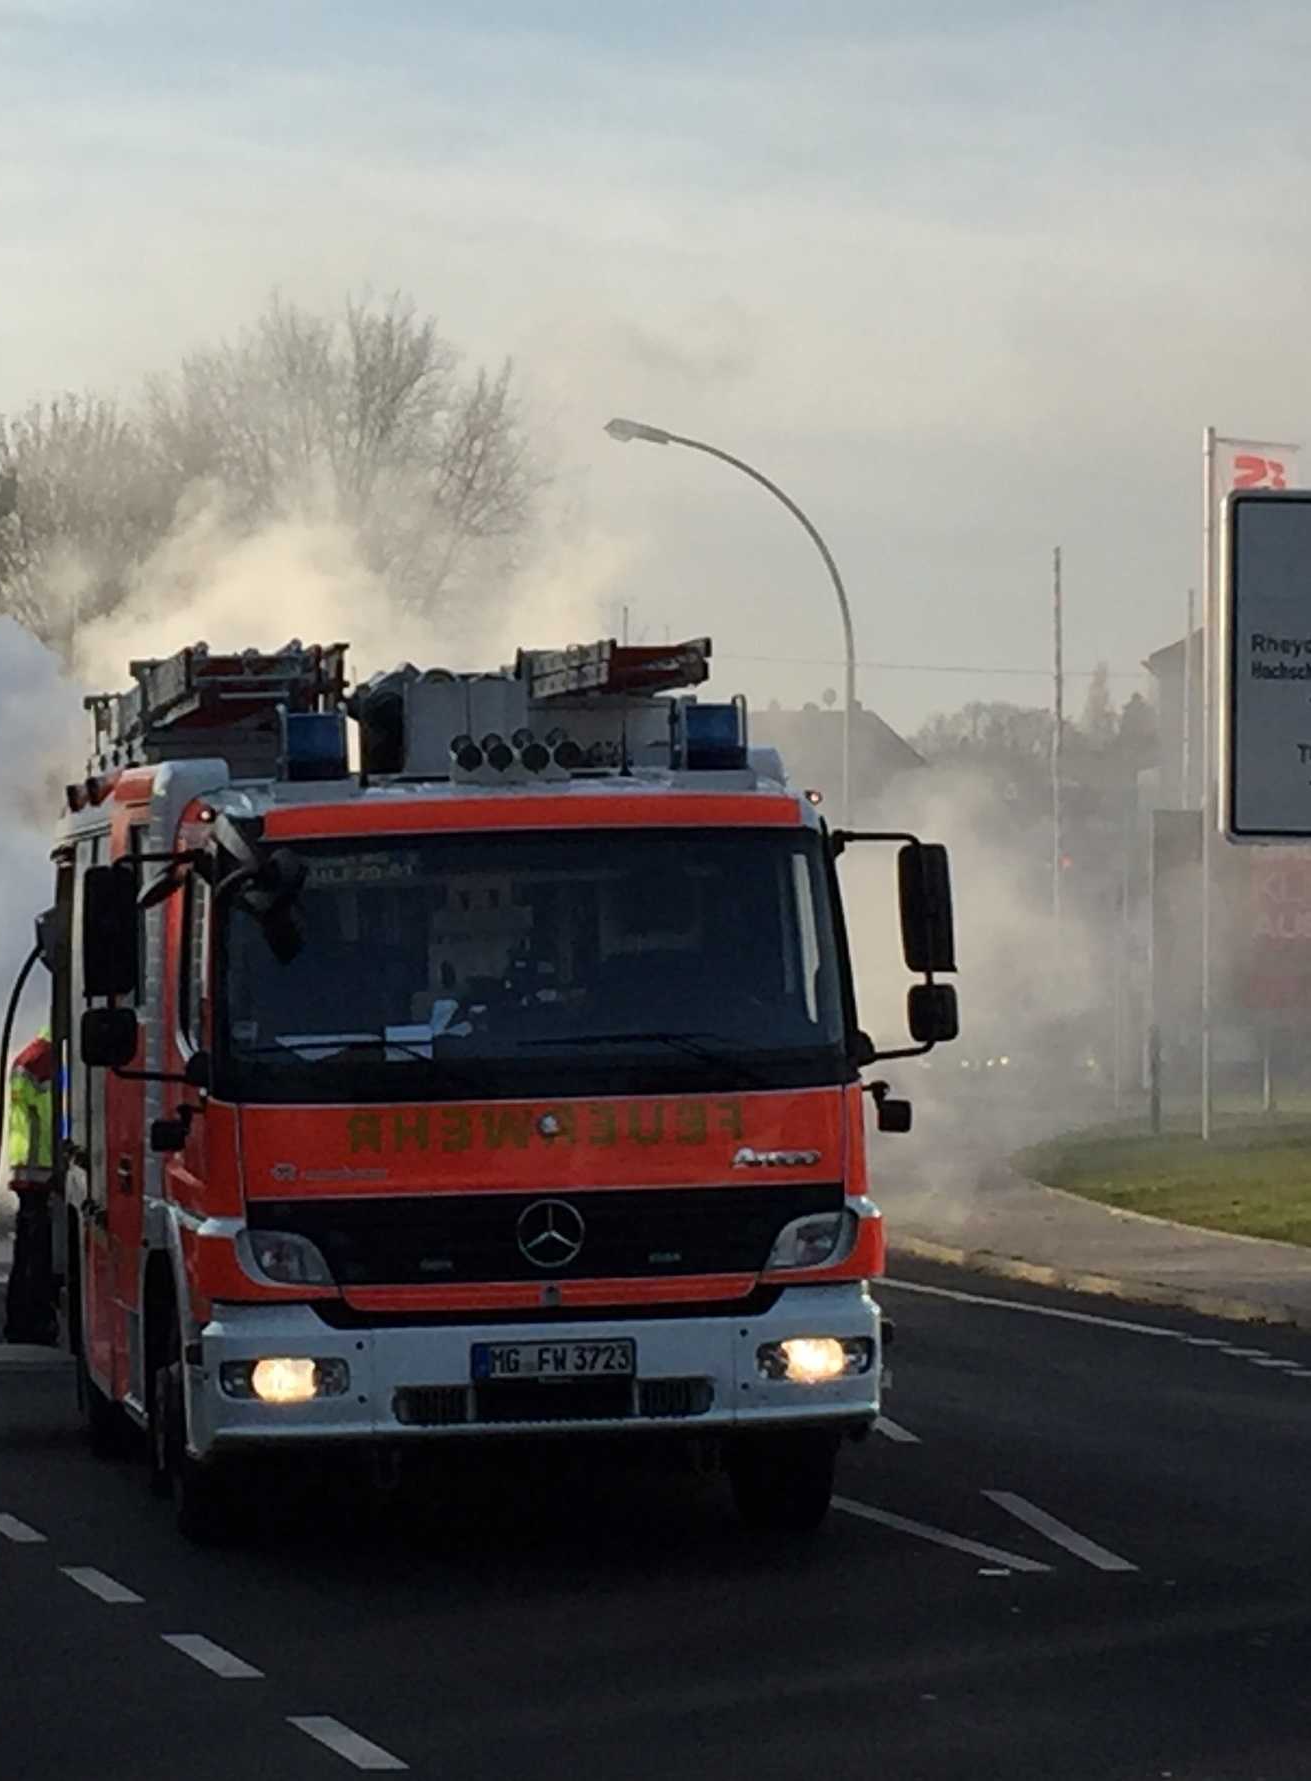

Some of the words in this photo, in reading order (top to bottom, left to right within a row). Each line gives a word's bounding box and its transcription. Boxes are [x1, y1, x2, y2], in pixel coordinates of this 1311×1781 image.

[1297, 743, 1311, 763] T
[491, 1349, 520, 1373] MG
[539, 1347, 567, 1371] FW
[573, 1345, 629, 1370] 3723
